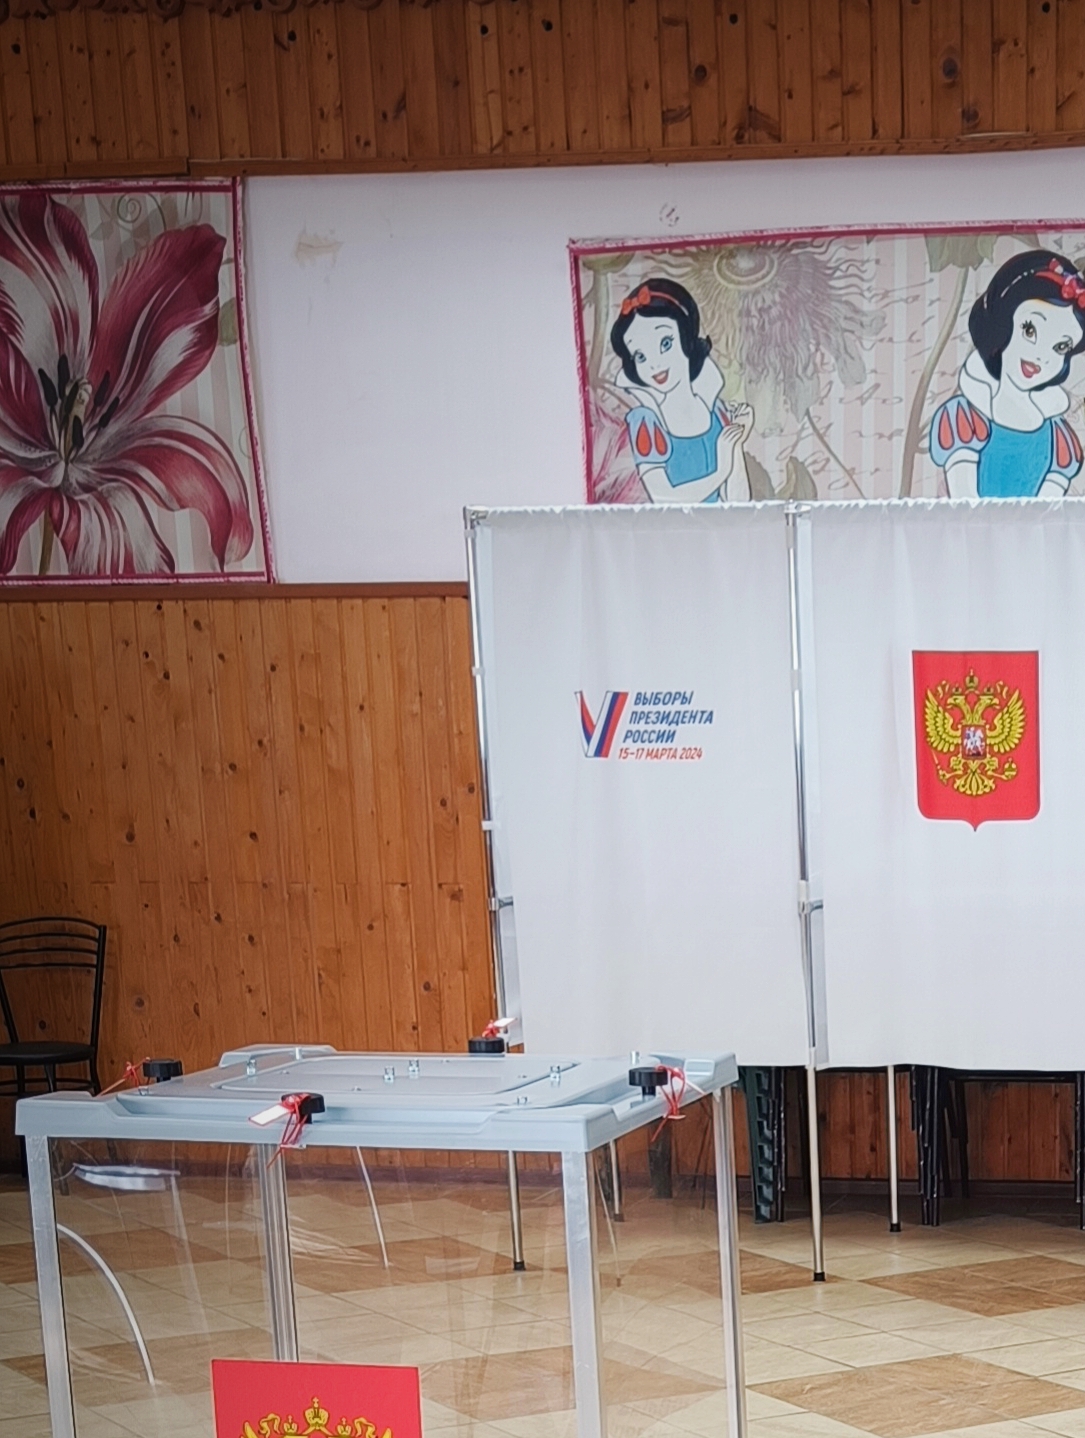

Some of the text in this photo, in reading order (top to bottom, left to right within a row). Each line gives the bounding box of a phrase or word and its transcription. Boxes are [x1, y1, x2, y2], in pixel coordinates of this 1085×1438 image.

[634, 691, 694, 706] ВЫБОРЫ
[629, 710, 714, 726] ПРЕЗИДЕНТА
[623, 730, 677, 743] РОССИИ
[645, 748, 677, 760] МАРТА
[679, 748, 703, 760] 2024
